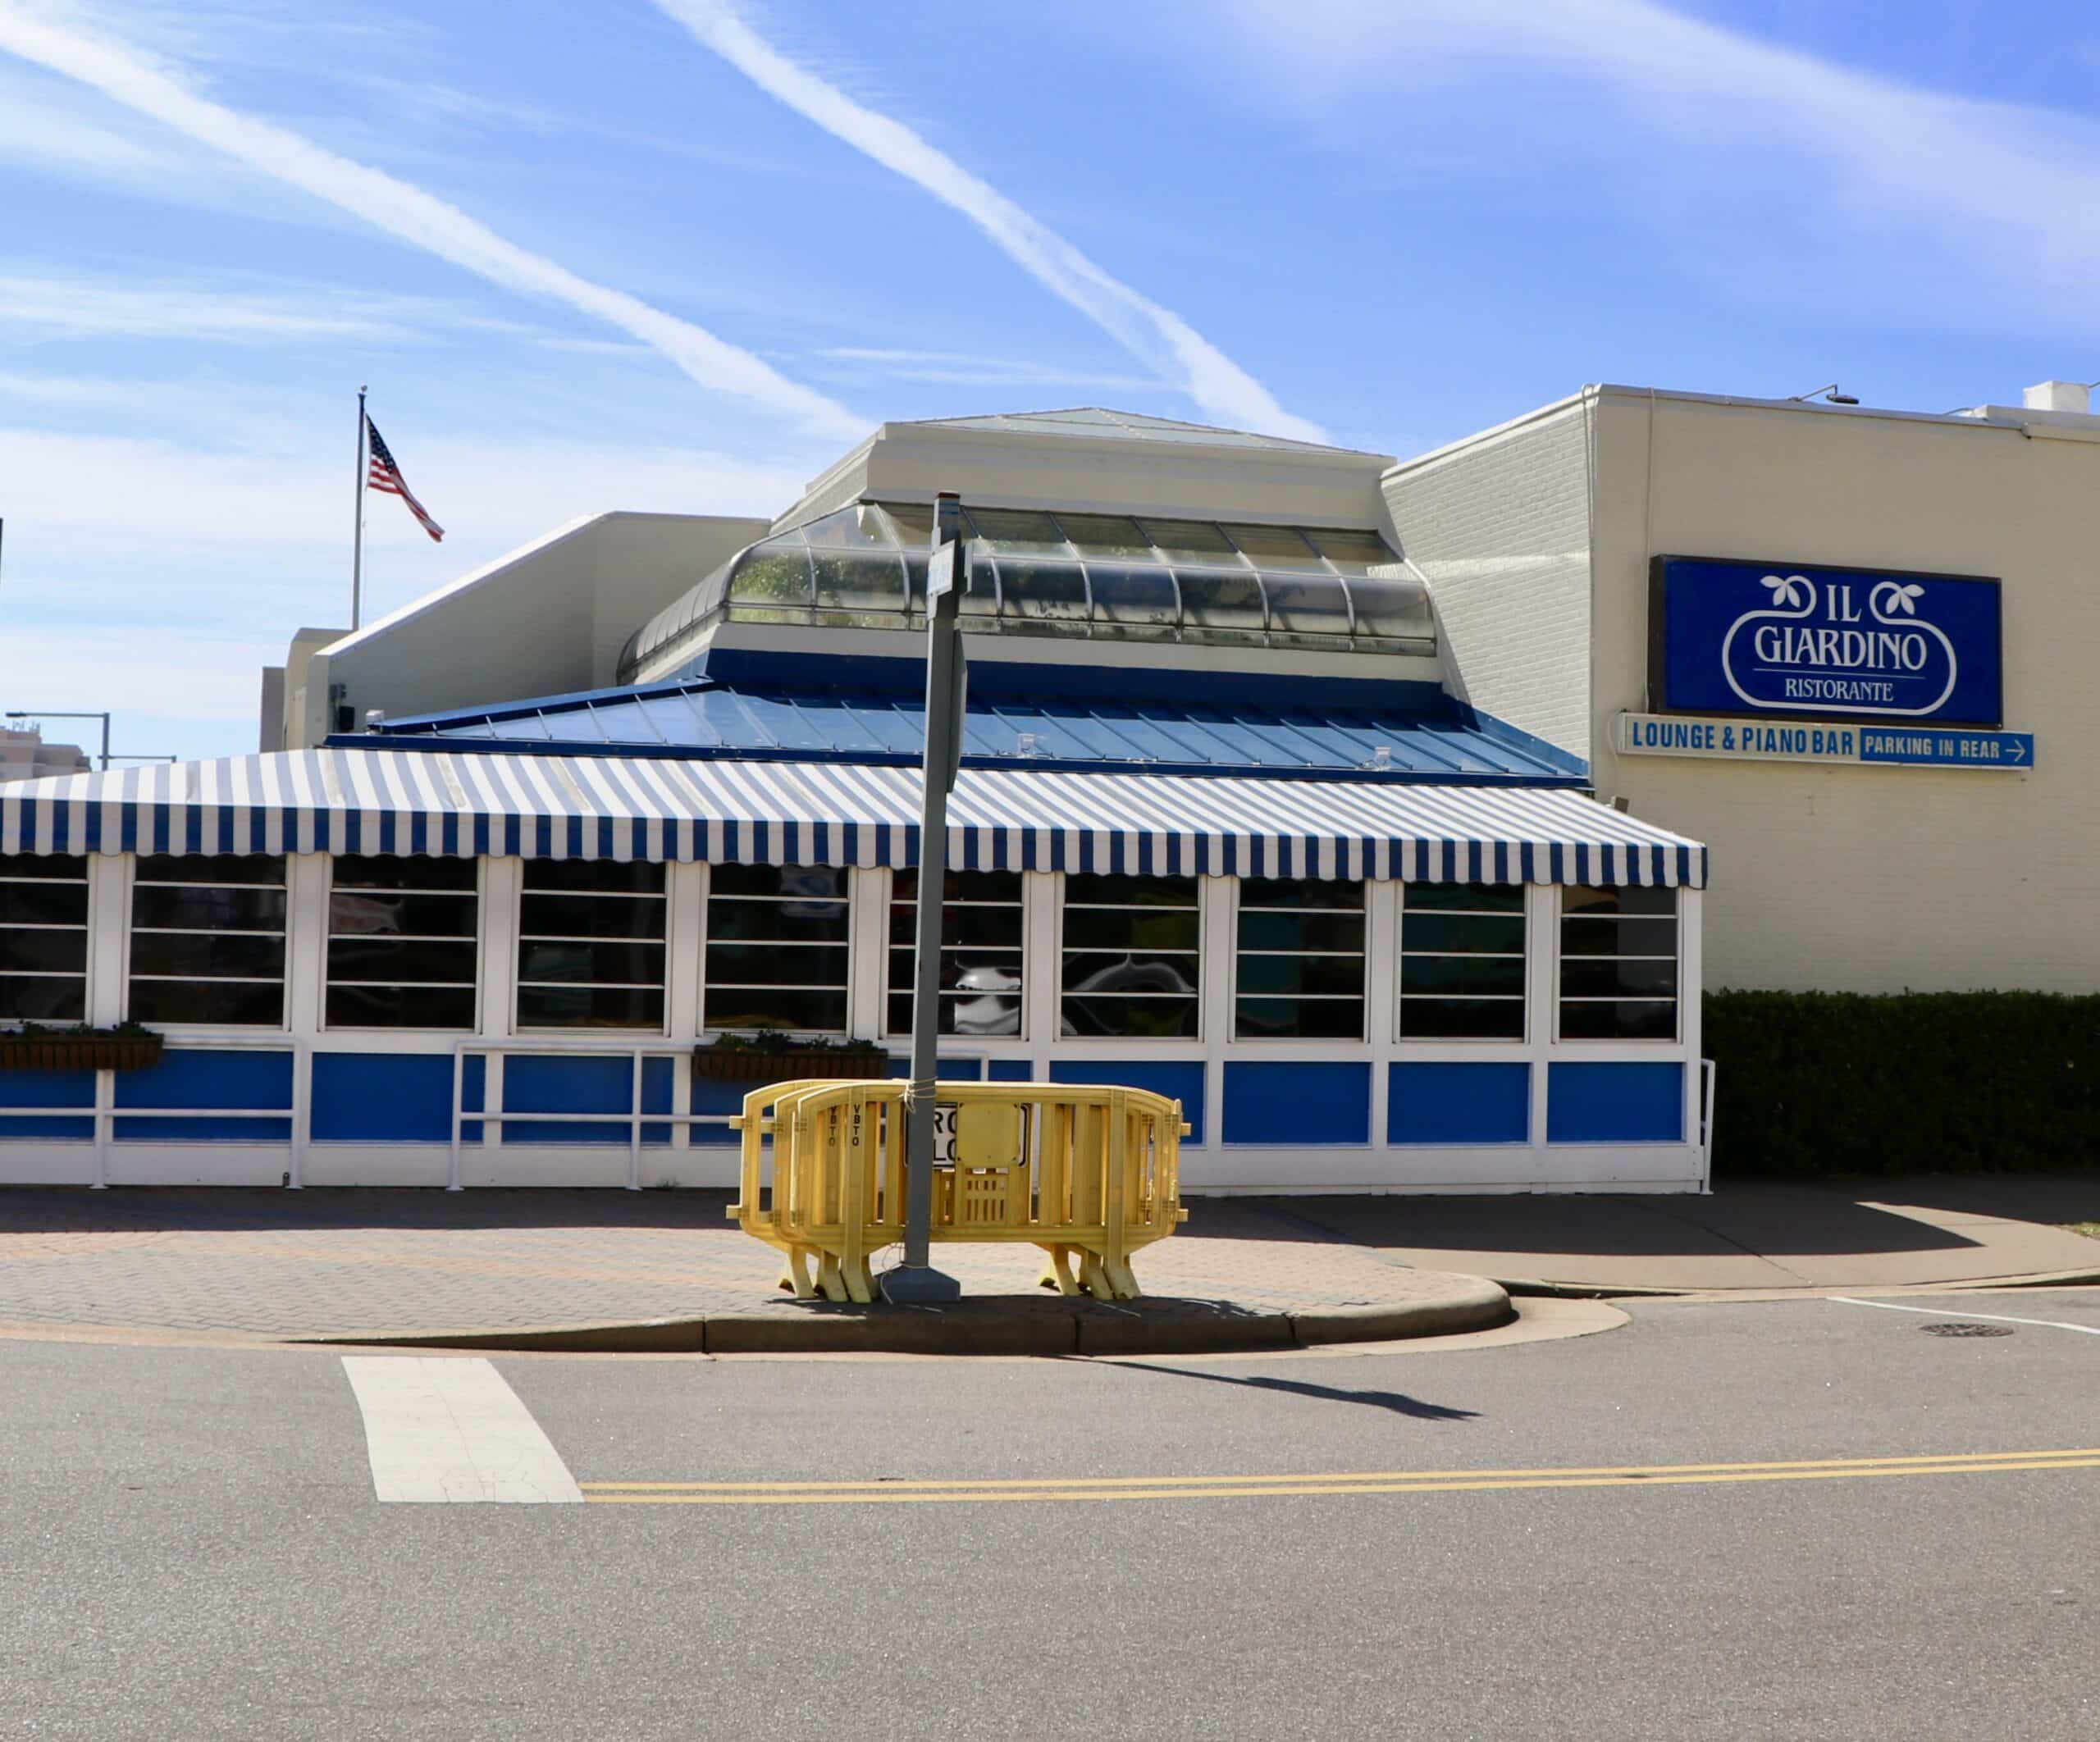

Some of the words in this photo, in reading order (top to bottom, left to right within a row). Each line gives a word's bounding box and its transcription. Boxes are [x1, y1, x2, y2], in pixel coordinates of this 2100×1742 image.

[1826, 584, 1862, 622] IL
[1754, 625, 1928, 671] GIARDINO
[1784, 677, 1895, 702] RISTORANTE
[1632, 721, 1715, 750] LOUNGE
[1722, 726, 1736, 750] &
[1742, 727, 1807, 753] PIANO
[1811, 730, 1854, 755] BAR
[1865, 735, 1933, 756] PARKING
[1938, 738, 1954, 757] IN
[1960, 740, 2000, 759] REAR
[852, 1103, 861, 1147] VBTO
